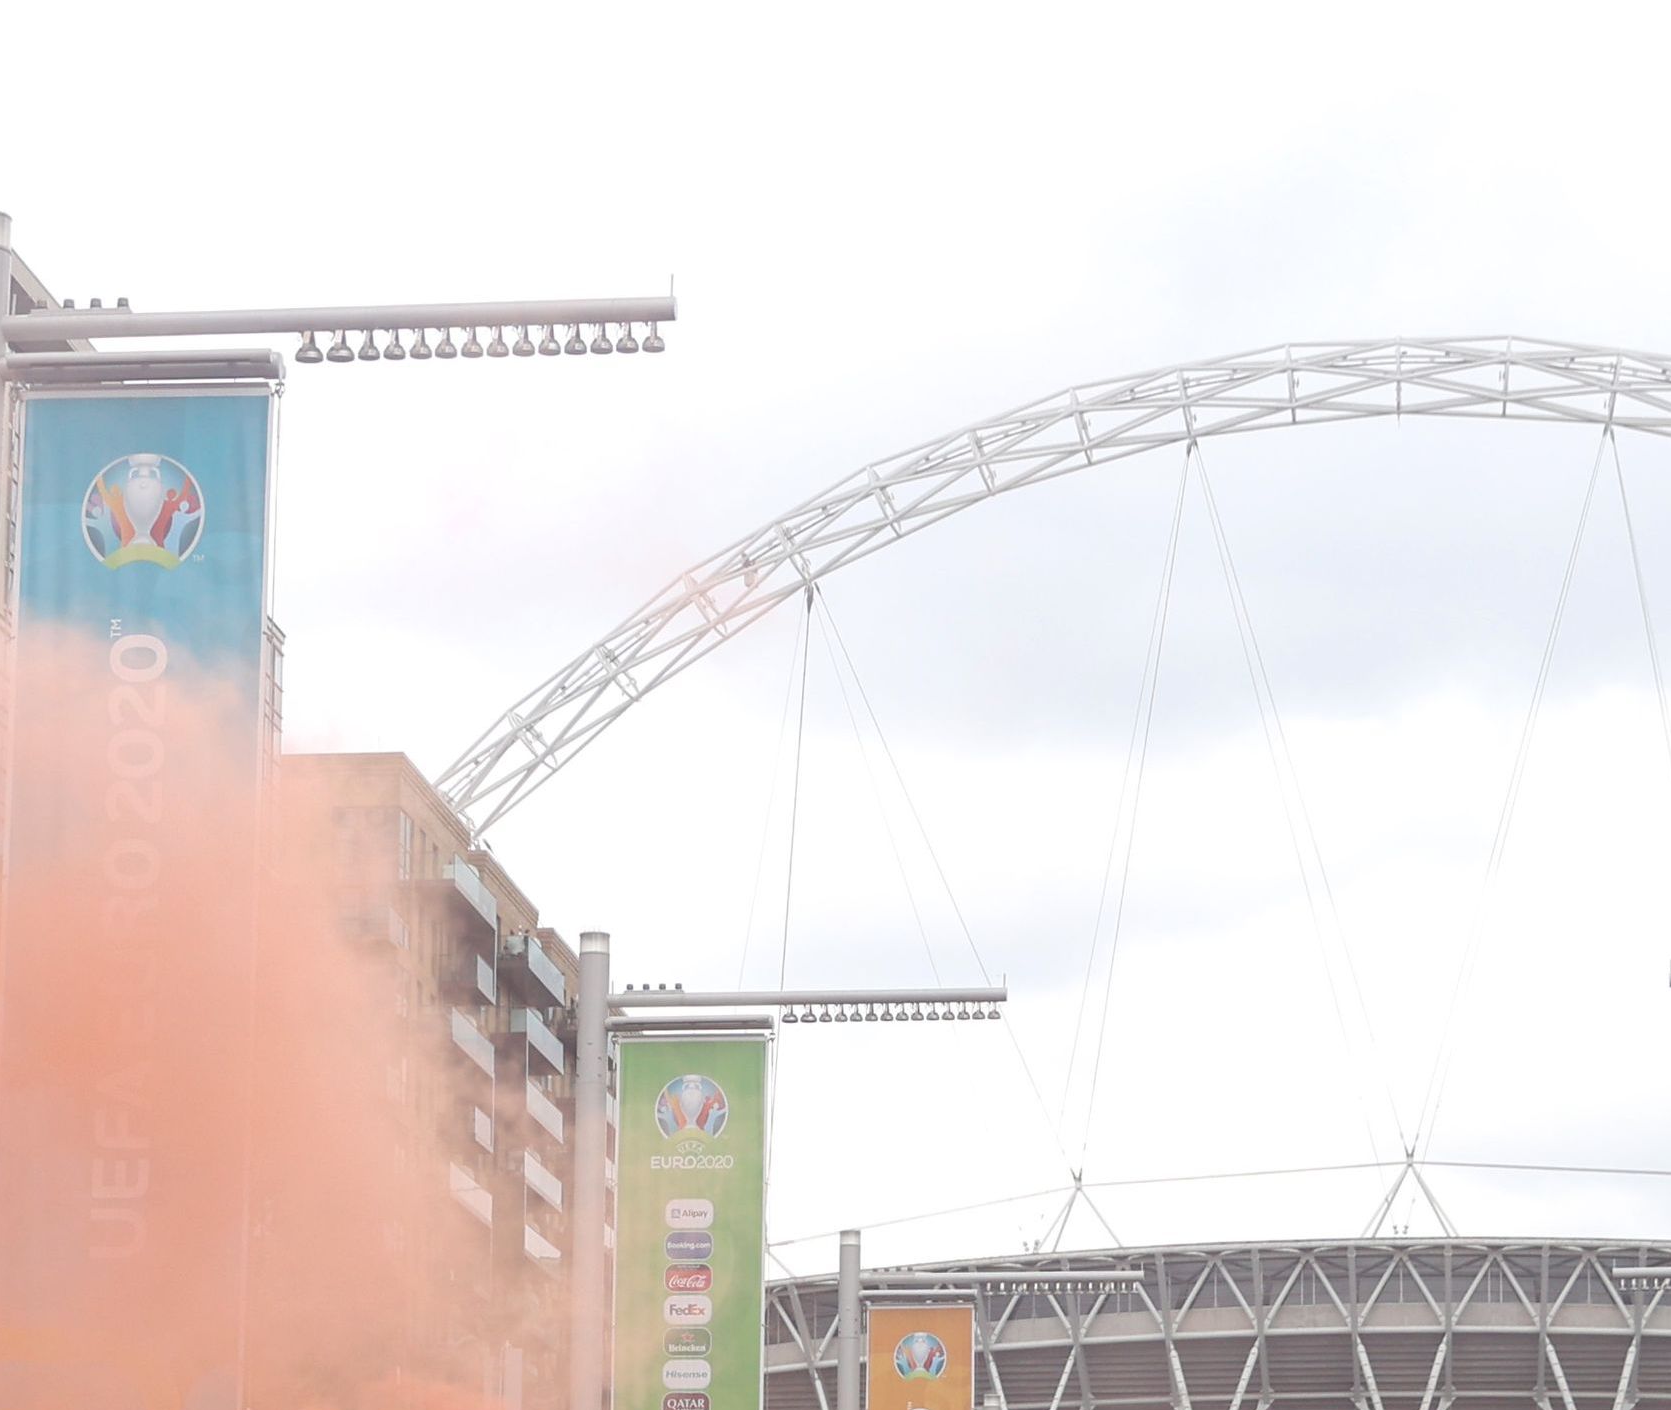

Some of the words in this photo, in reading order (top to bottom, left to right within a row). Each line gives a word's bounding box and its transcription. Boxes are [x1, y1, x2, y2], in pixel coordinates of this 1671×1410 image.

[104, 632, 169, 828] 2020
[88, 1058, 154, 1262] UEFA
[681, 1208, 708, 1219] Alipay
[669, 1303, 705, 1316] FedEx
[665, 1369, 708, 1379] Hisense
[667, 1399, 705, 1410] QATAR
